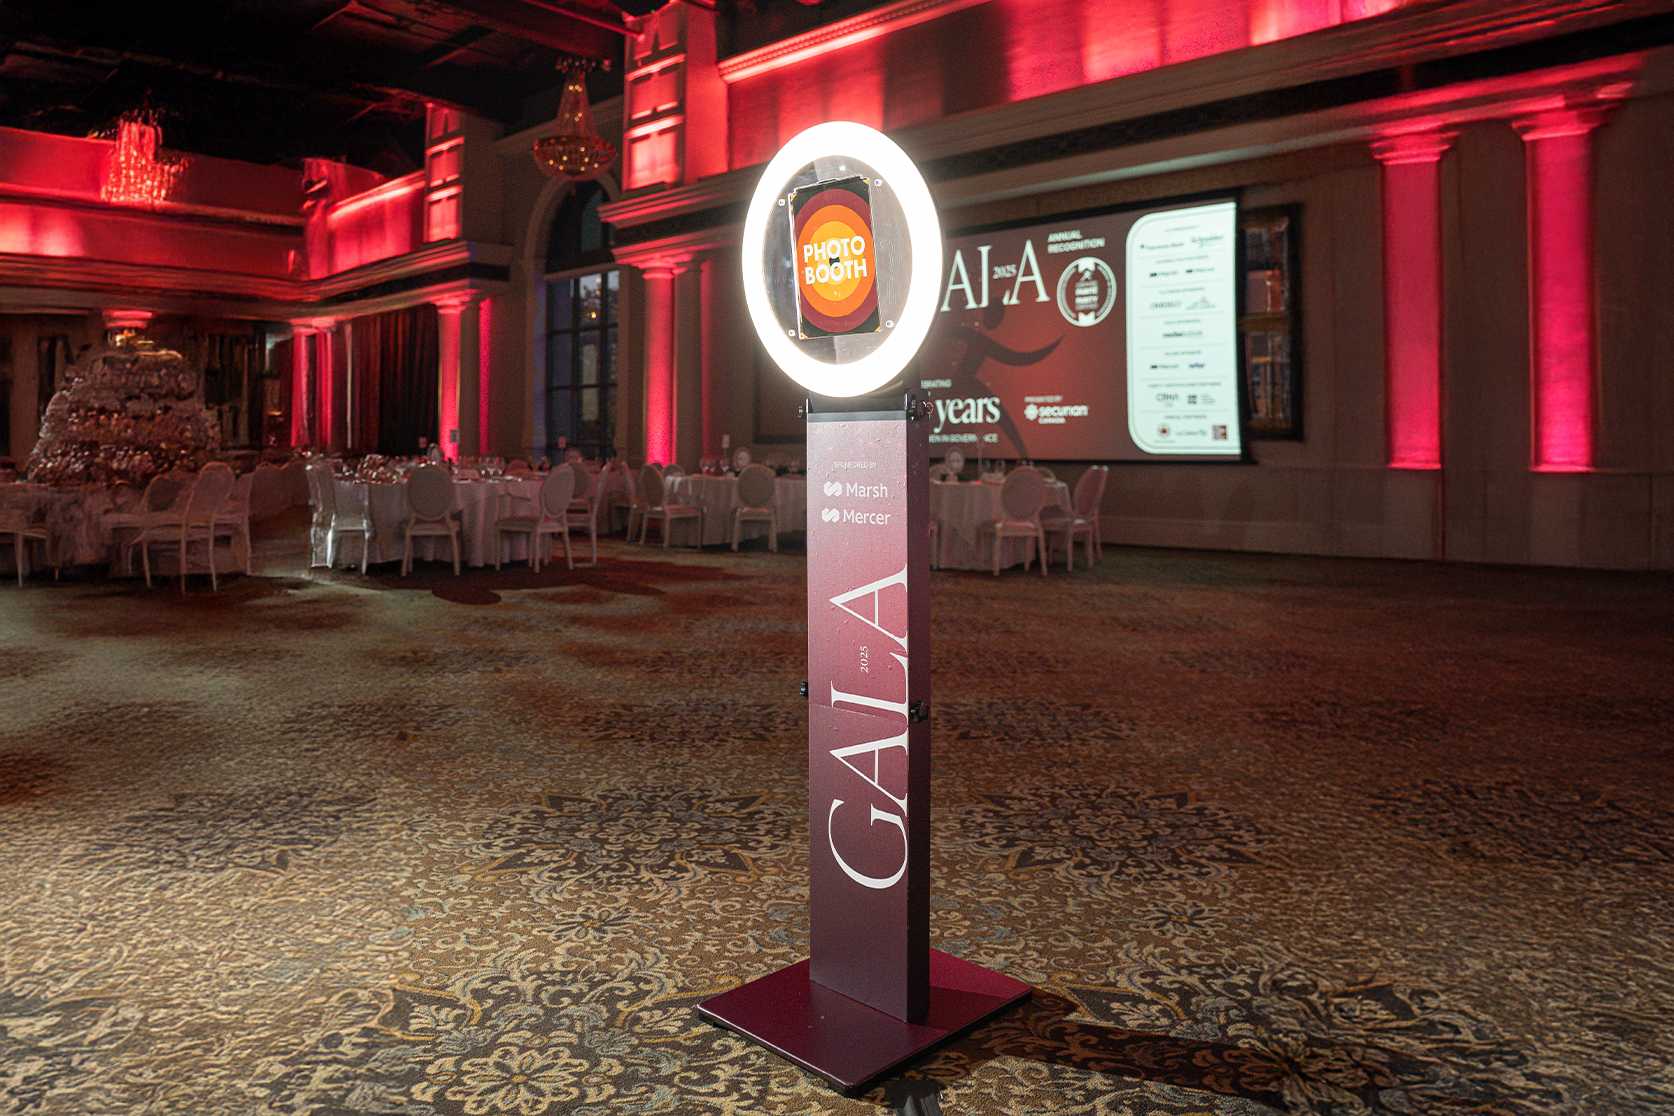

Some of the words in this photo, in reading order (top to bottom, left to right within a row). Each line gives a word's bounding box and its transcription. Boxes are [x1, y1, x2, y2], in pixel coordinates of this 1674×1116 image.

[803, 236, 866, 263] PHOTO
[805, 259, 868, 284] BOOTH
[993, 264, 1017, 279] 2025
[933, 396, 1001, 433] years
[1038, 405, 1089, 417] securian
[846, 482, 888, 498] Marsh
[842, 509, 891, 525] Mercer
[860, 645, 869, 674] 2025
[828, 563, 908, 889] GALA
